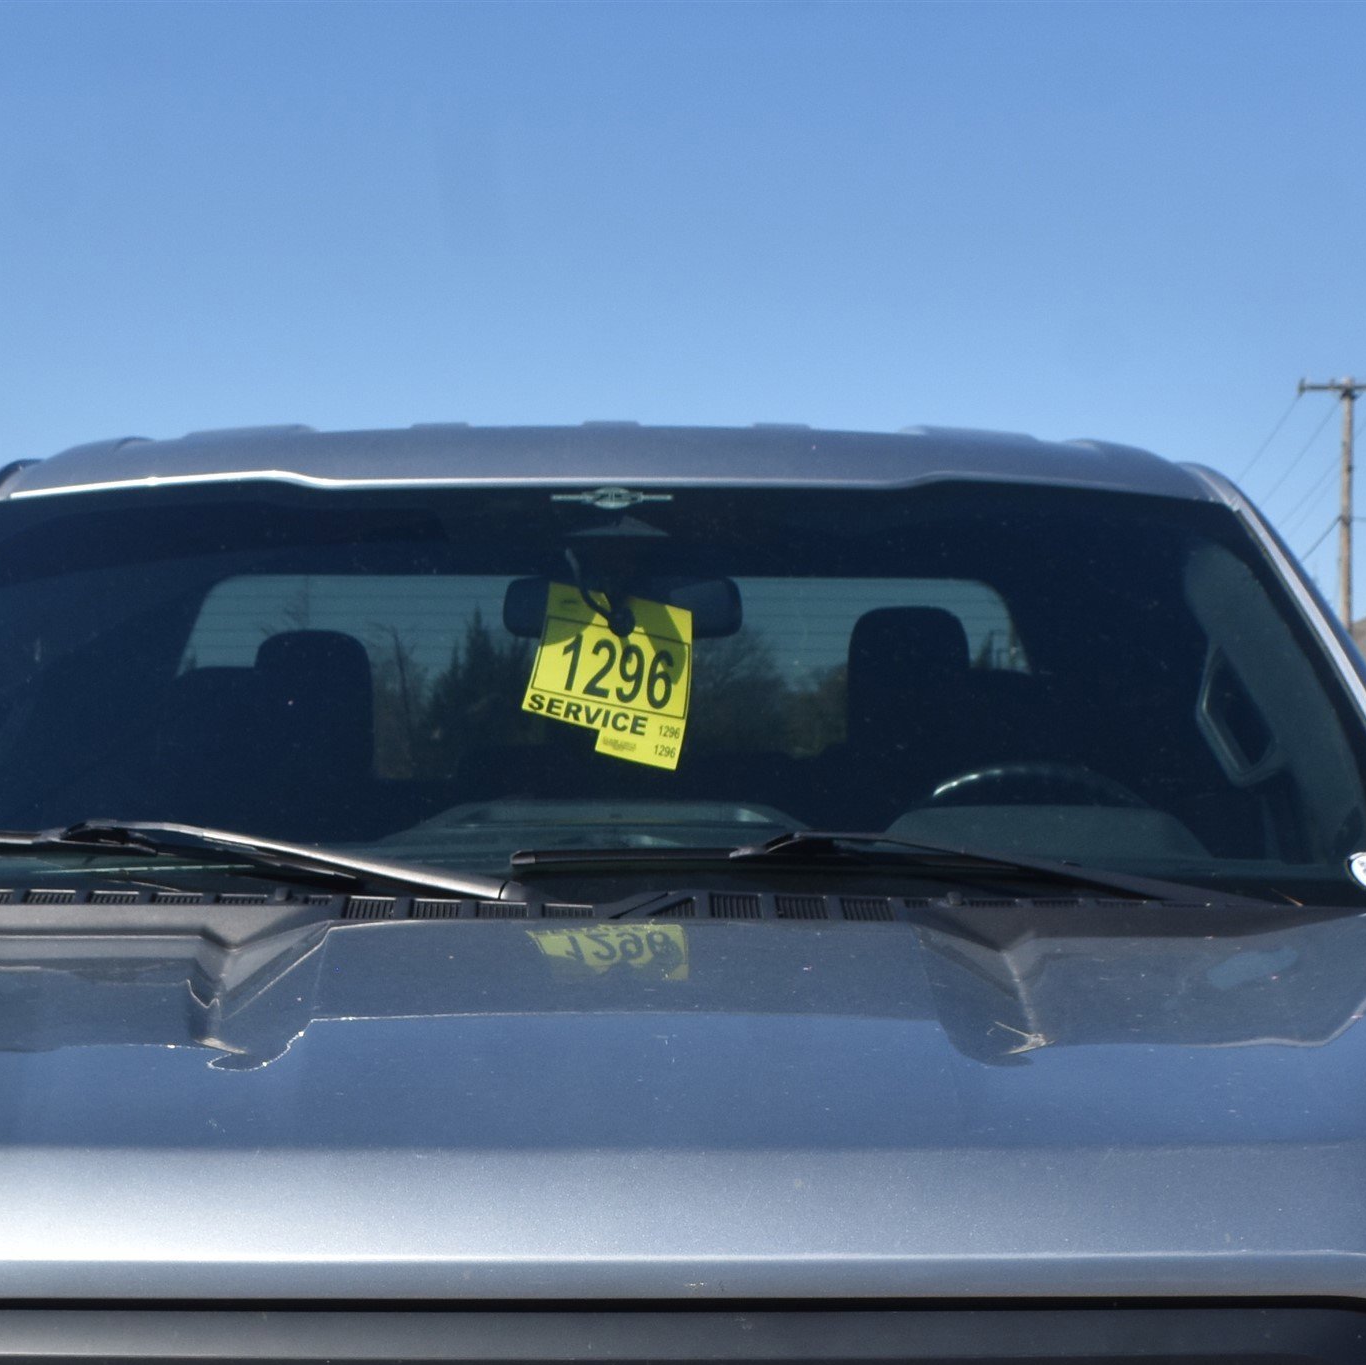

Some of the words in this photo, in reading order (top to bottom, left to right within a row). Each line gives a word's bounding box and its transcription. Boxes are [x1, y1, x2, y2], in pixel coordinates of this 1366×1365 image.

[562, 633, 674, 709] 1296
[528, 694, 648, 735] SERVICE
[658, 724, 681, 740] 1296
[653, 743, 677, 759] 1296
